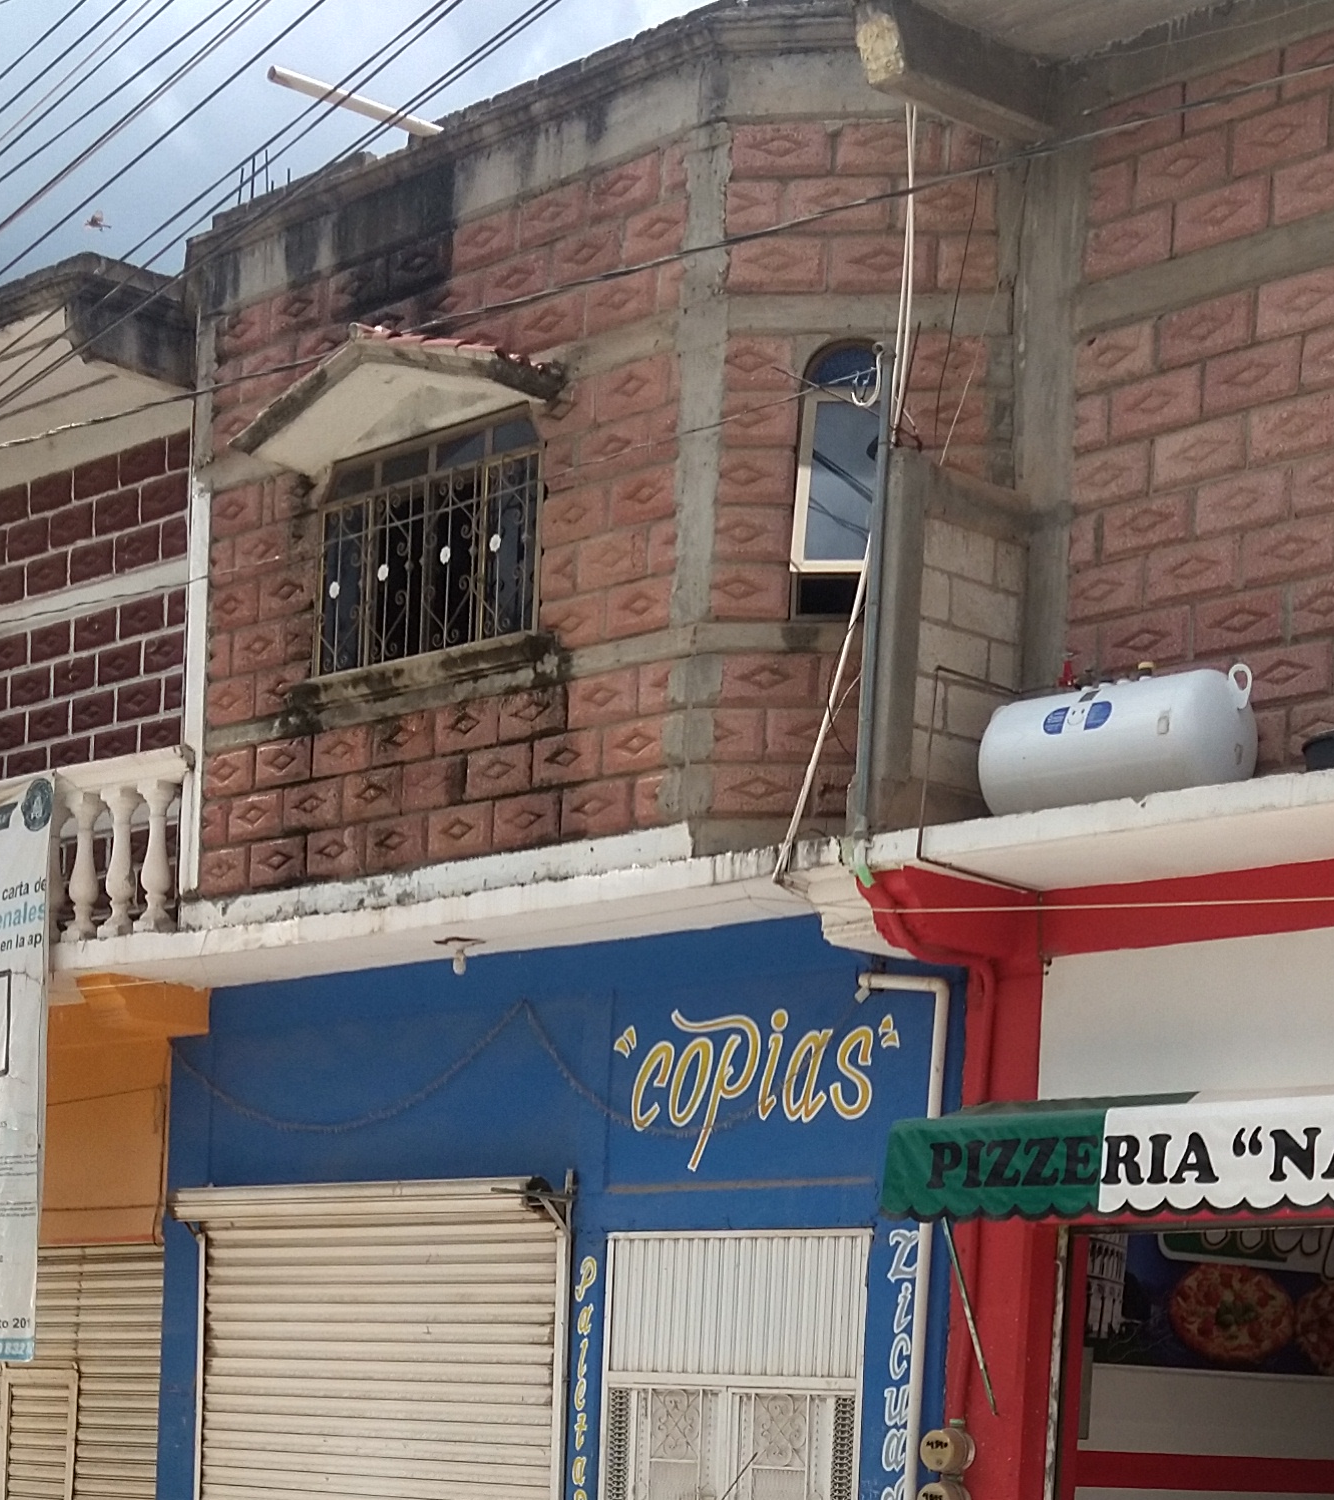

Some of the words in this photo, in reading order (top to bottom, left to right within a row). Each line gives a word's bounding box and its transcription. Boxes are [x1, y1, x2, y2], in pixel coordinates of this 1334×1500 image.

[2, 882, 29, 902] carta
[0, 939, 12, 953] en
[16, 933, 25, 949] la
[929, 1132, 1220, 1191] PIZZERIA
